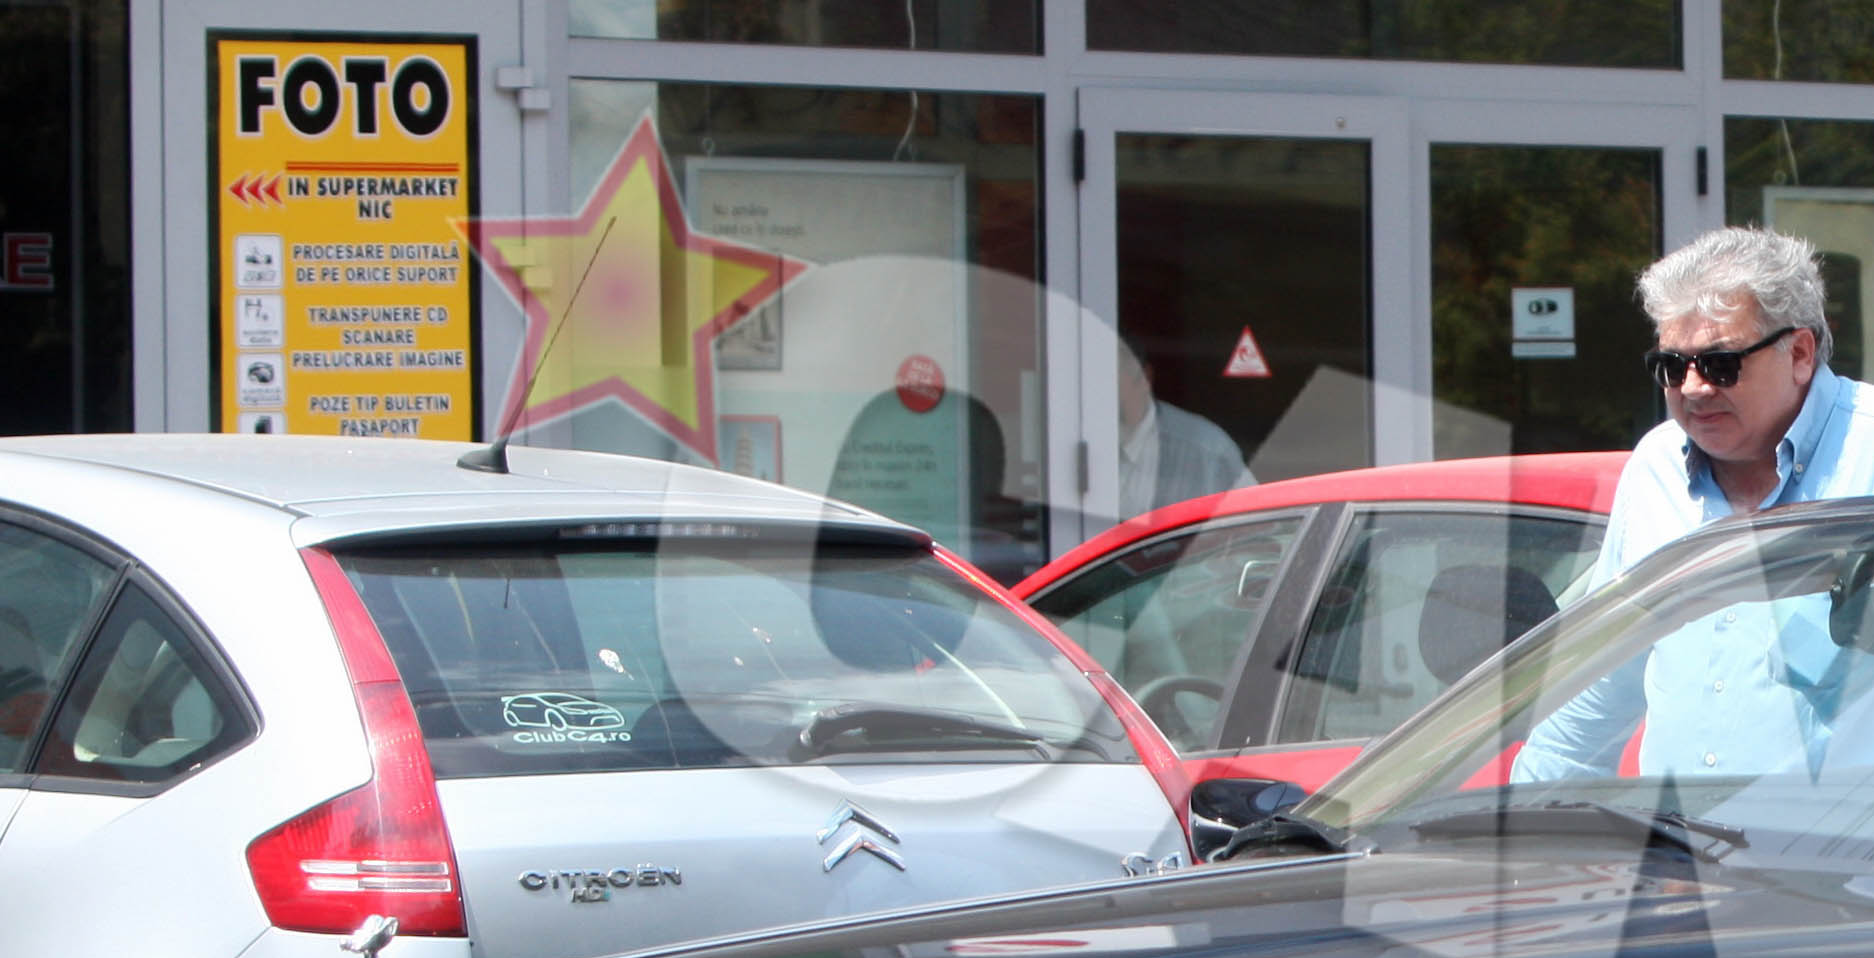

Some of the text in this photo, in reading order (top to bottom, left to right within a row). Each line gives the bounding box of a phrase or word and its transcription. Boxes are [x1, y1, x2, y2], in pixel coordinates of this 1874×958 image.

[238, 55, 451, 137] FOTO
[287, 177, 458, 197] IN SUPERMARKET
[358, 200, 393, 219] NIC
[292, 244, 384, 260] PROCESARE
[295, 266, 458, 282] DE PE ORICE SUPORT
[308, 307, 448, 323] TRANSPUNERE CD
[342, 328, 414, 345] SCANARE
[292, 351, 463, 368] PRELUCRARE IMAGINE
[309, 396, 450, 412] POZE TIP BULETIN
[512, 730, 632, 744] ClubC4.ro
